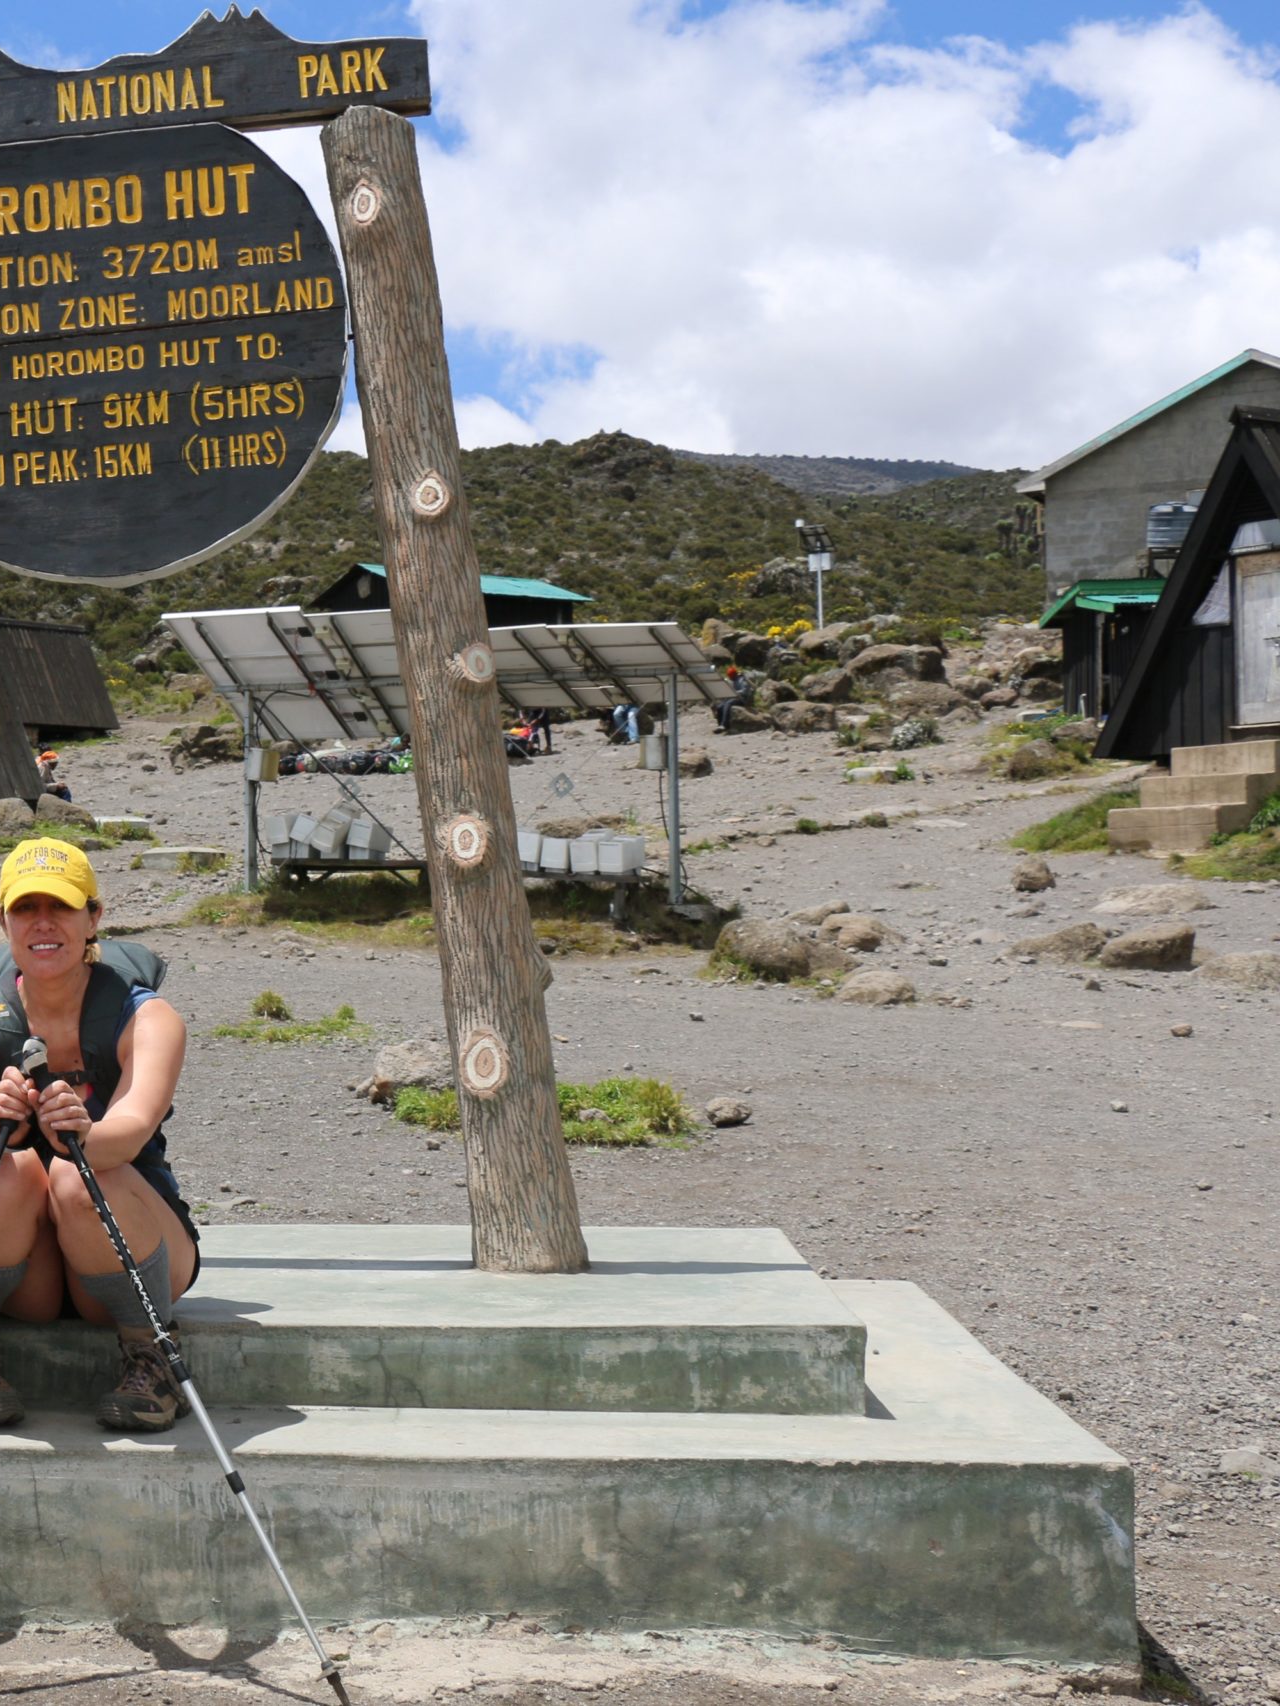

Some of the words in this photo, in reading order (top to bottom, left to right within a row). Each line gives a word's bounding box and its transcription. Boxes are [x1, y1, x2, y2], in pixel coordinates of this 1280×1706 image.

[56, 65, 225, 123] NATIONAL
[298, 47, 388, 98] PARK
[165, 163, 255, 221] HUT
[102, 238, 219, 279] 3720M
[237, 230, 302, 267] amsl
[58, 292, 146, 331] ZONE:
[168, 277, 334, 321] MOORLAND
[12, 343, 145, 380] HOROMBO
[159, 336, 221, 368] HUT
[236, 332, 283, 361] TO:
[9, 397, 85, 437] HUT:
[103, 389, 169, 429] 9KM
[190, 377, 305, 427] (5HRS)
[13, 448, 88, 487] PEAK:
[94, 442, 152, 479] 15KM
[34, 846, 49, 858] FOR
